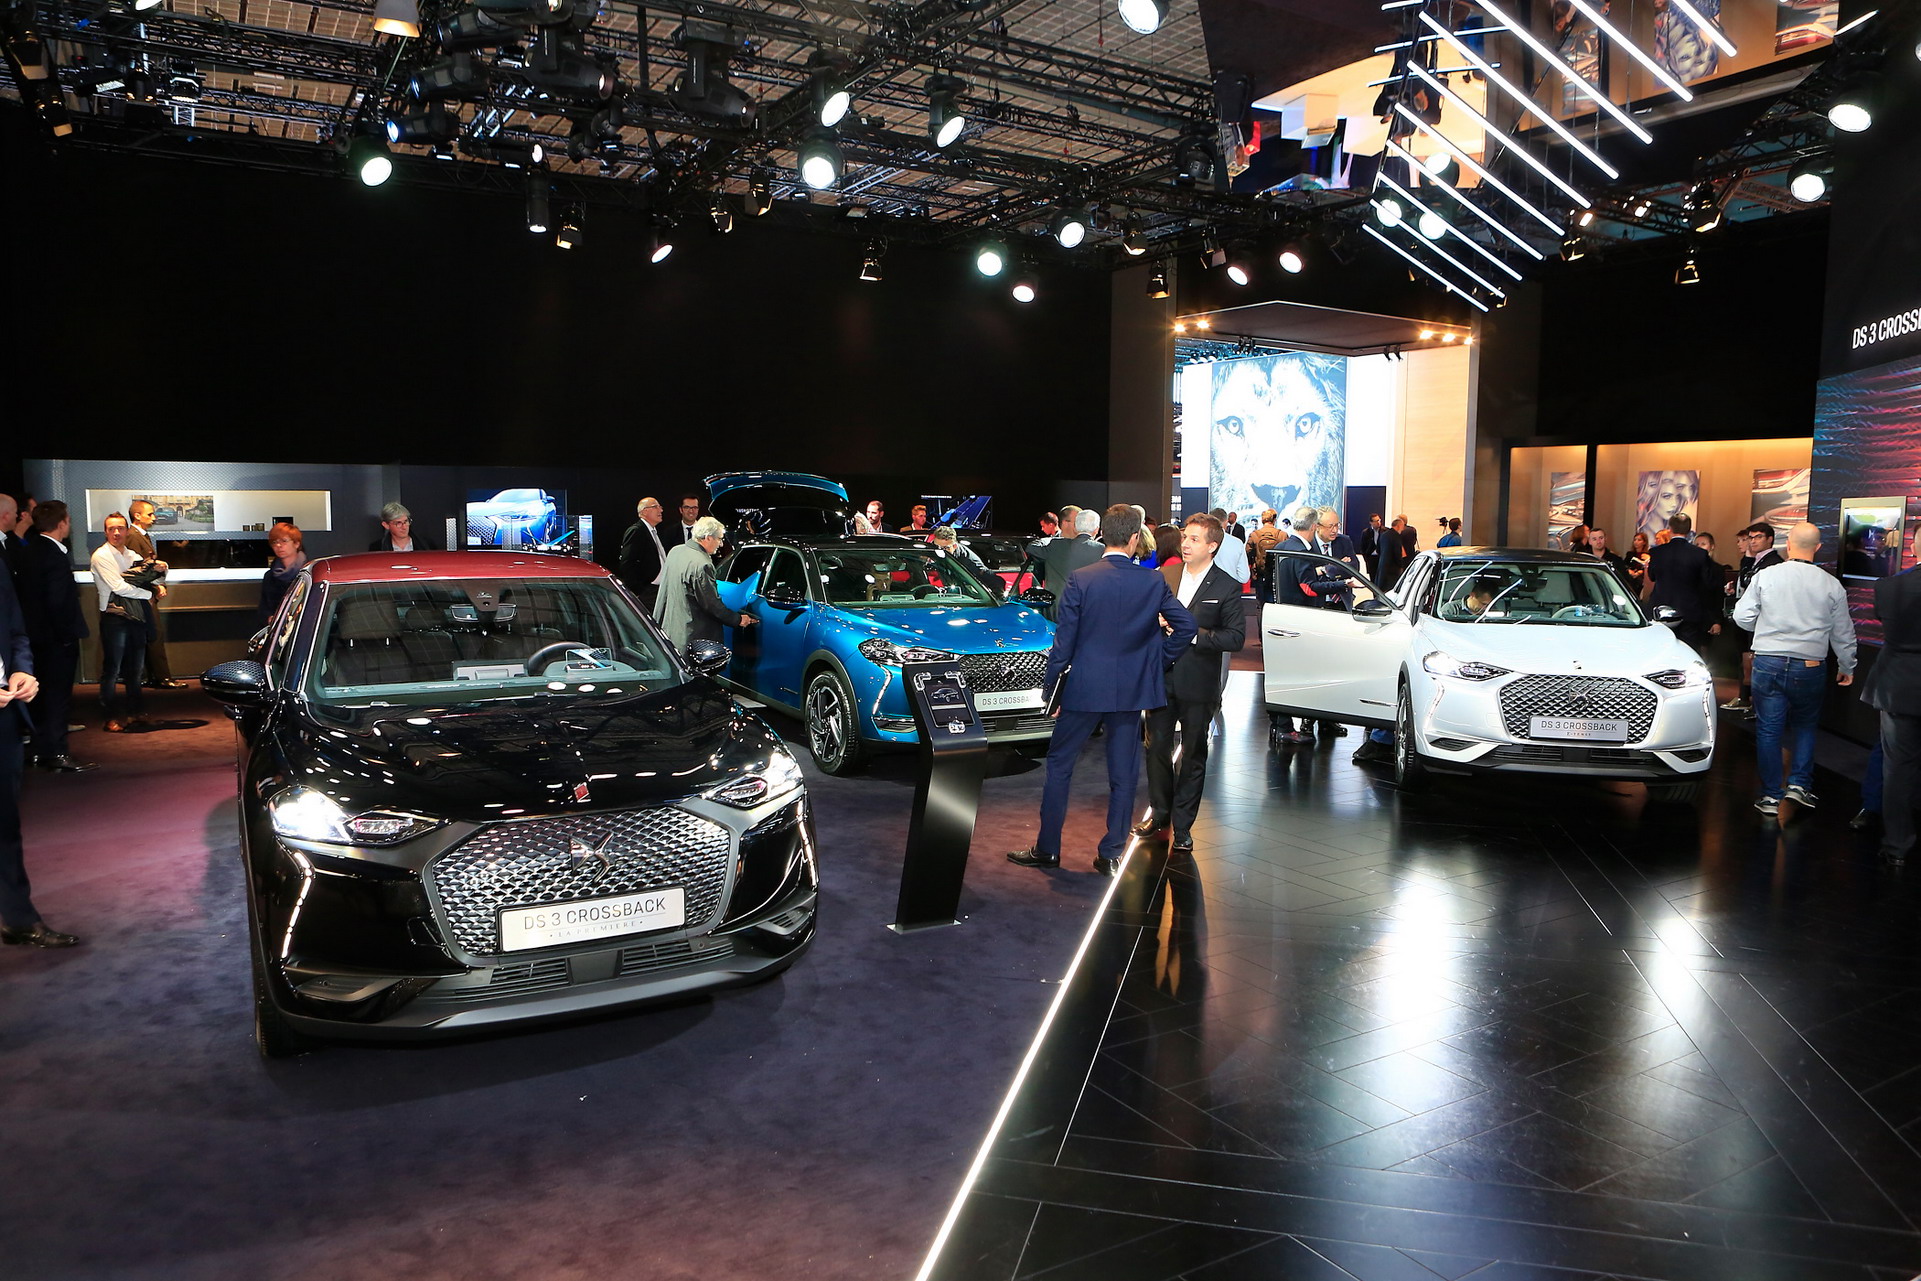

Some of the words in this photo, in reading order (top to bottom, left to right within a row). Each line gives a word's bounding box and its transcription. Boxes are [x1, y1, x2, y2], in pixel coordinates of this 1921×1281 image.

[1852, 325, 1868, 349] DS
[1868, 322, 1877, 344] 3
[982, 698, 992, 706] DS
[993, 697, 998, 705] 3
[1541, 720, 1553, 729] DS
[1555, 721, 1561, 729] 3
[1563, 721, 1618, 731] CROSSBACK
[524, 914, 546, 930] DS
[551, 912, 561, 926] 3
[566, 897, 667, 925] CROSSBACK
